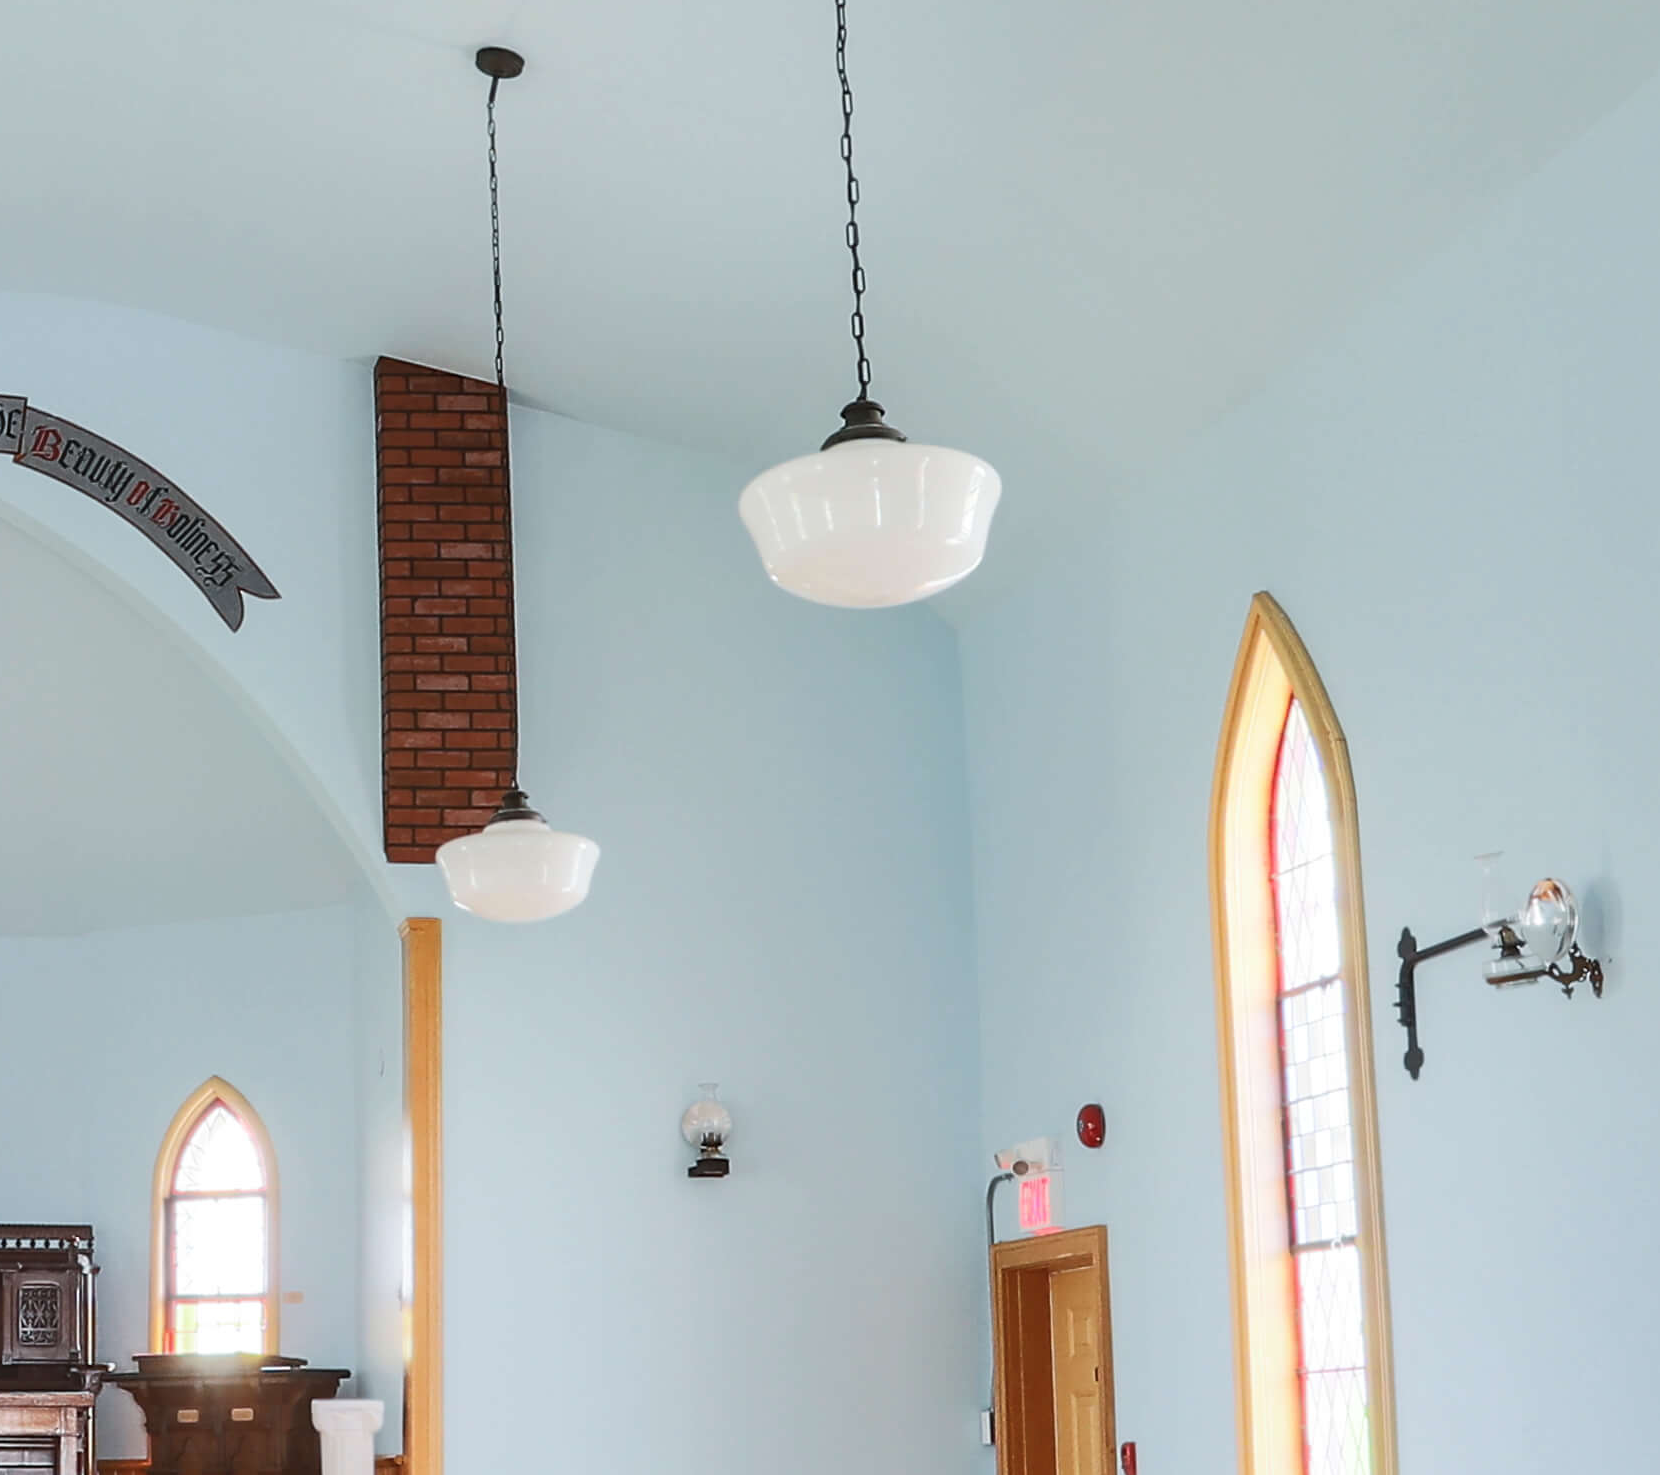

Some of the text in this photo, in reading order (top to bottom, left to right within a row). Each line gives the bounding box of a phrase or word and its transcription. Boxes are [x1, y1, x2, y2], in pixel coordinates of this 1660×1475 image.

[31, 426, 135, 502] Beauty
[150, 498, 241, 587] Holiness
[1020, 1177, 1050, 1229] EXIT
